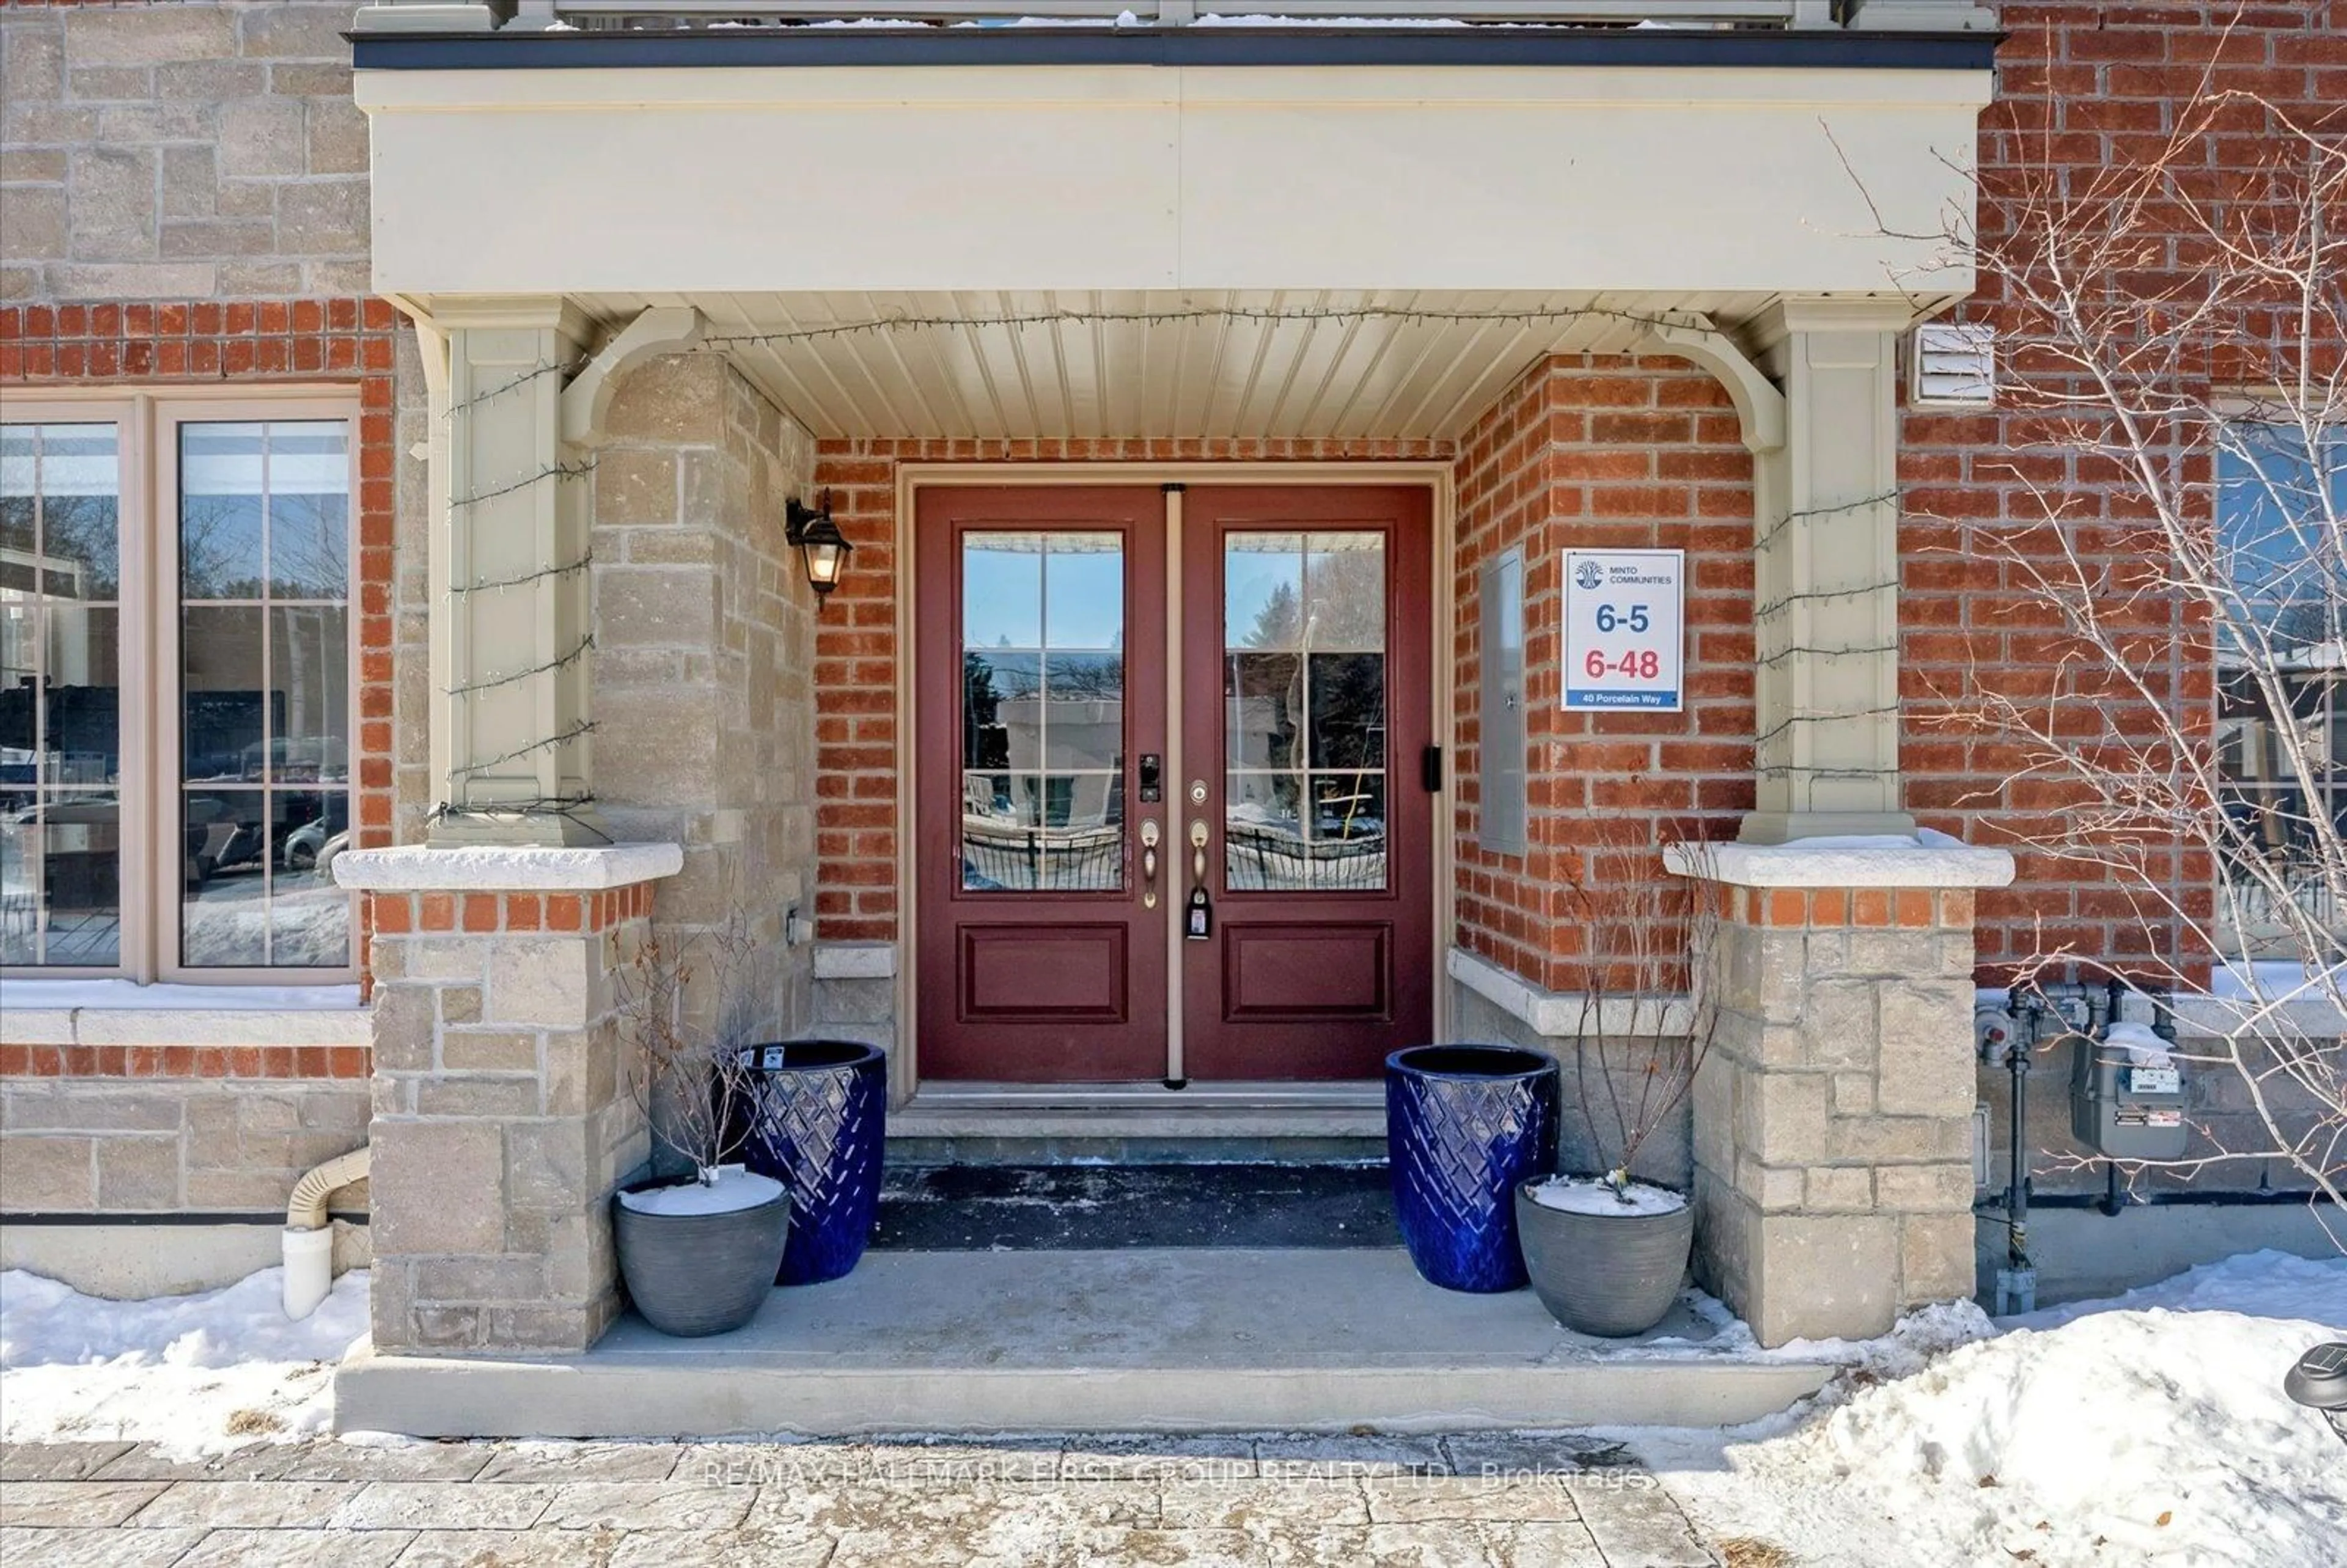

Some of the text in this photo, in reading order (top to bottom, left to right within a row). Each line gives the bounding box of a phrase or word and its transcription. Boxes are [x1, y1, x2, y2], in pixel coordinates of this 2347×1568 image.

[1596, 604, 1649, 633] 6-5
[1585, 650, 1659, 678] 6-48
[1582, 694, 1661, 705] 40 Porcelain Way
